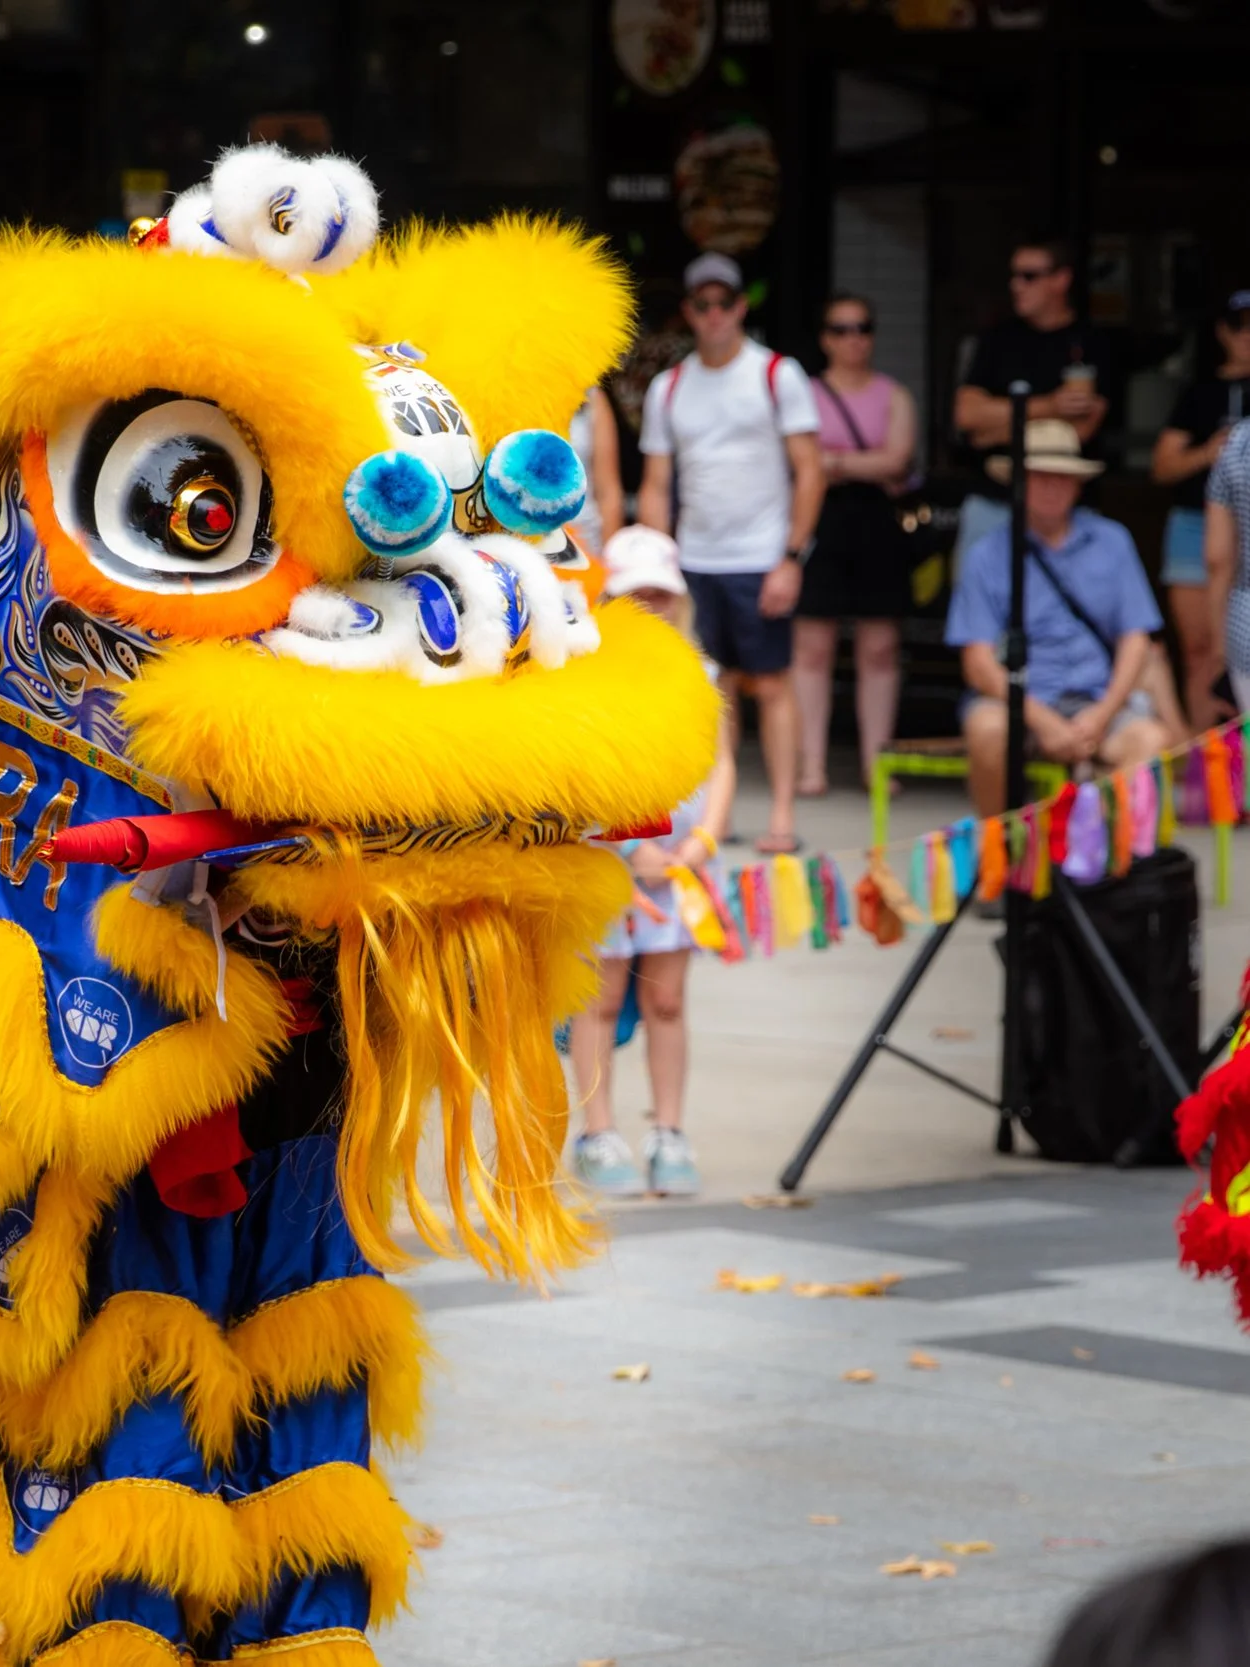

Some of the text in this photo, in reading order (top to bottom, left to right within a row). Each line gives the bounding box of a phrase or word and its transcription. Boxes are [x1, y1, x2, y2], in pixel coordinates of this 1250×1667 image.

[73, 993, 120, 1026] WE ARE
[5, 1224, 23, 1247] ARE
[29, 1472, 51, 1485] WE
